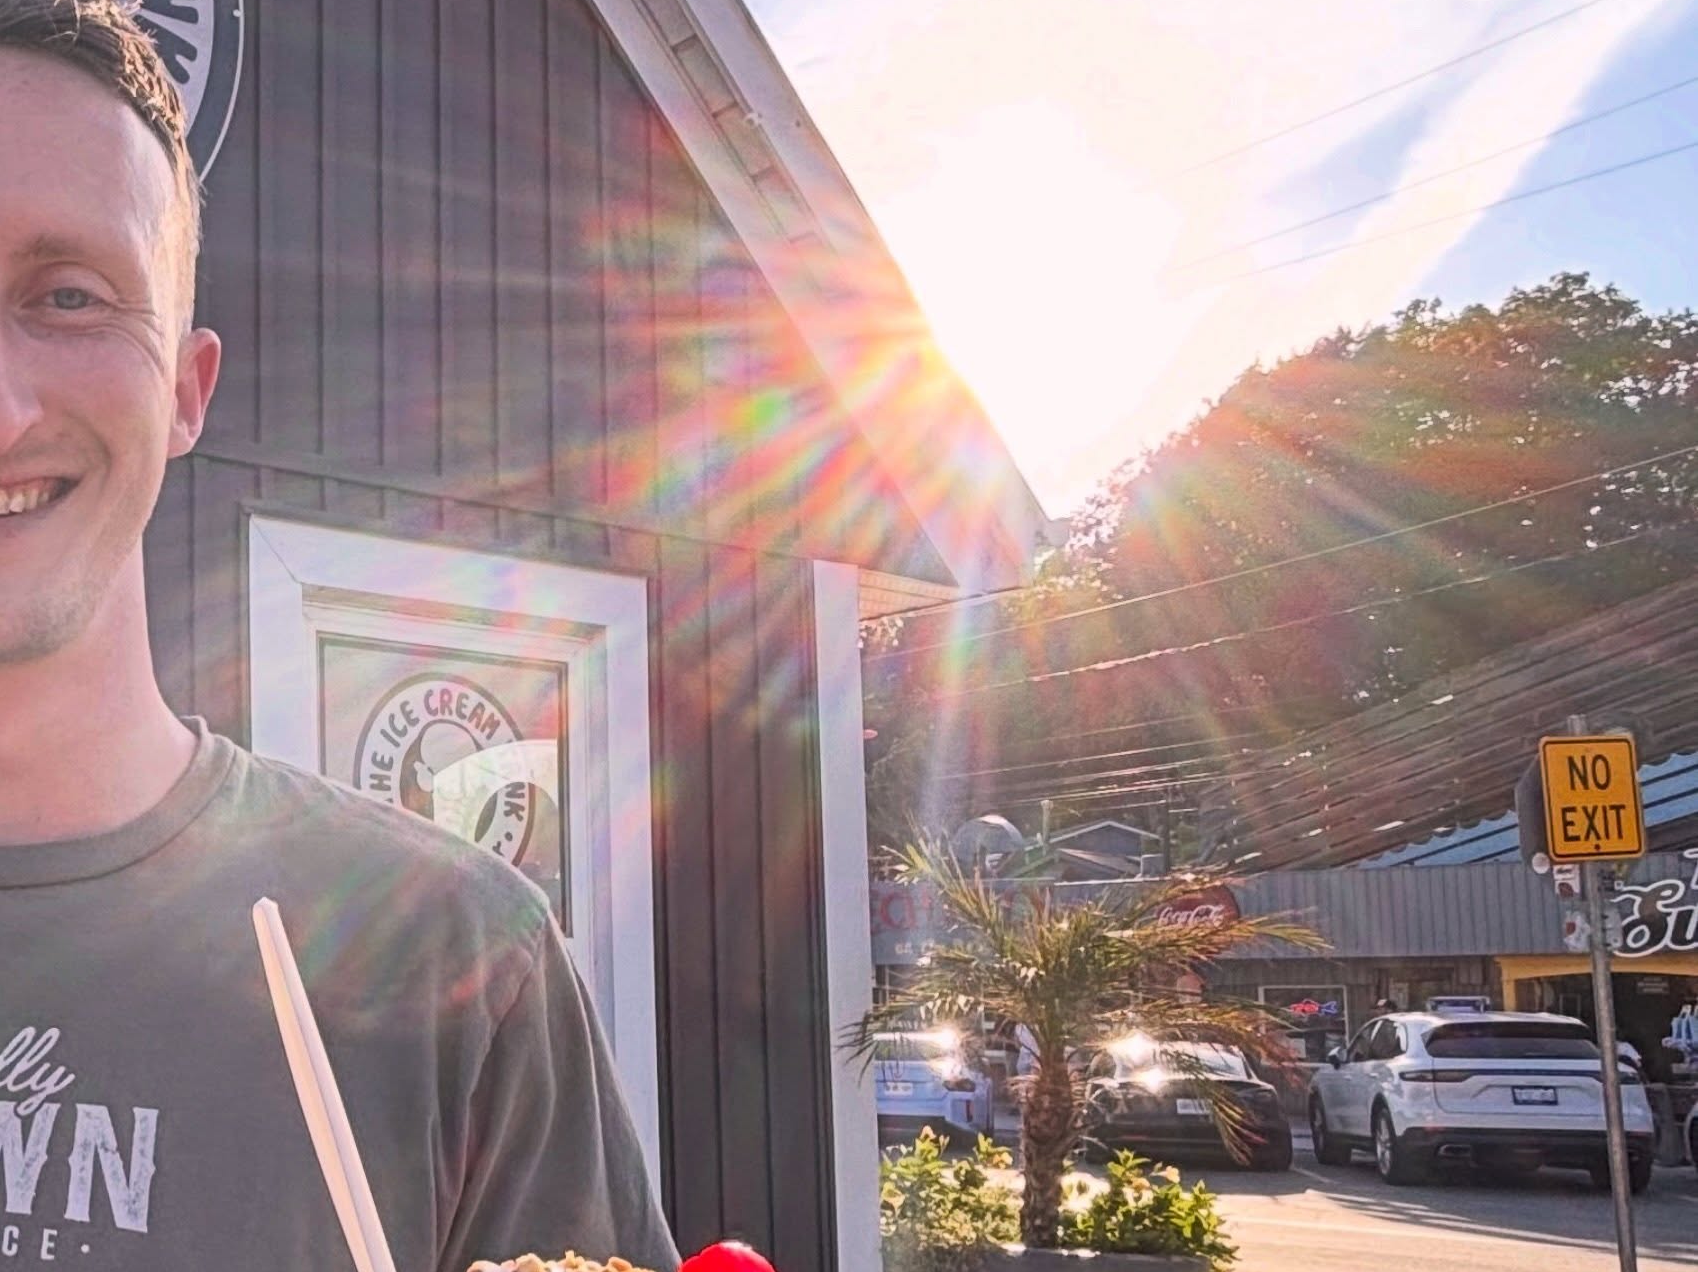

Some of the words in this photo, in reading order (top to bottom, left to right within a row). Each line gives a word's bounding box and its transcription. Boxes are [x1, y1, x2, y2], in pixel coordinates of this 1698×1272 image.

[380, 701, 419, 748] ICE
[424, 688, 501, 740] CREAM
[370, 751, 394, 803] HE
[1567, 754, 1611, 792] NO
[1561, 804, 1626, 843] EXIT
